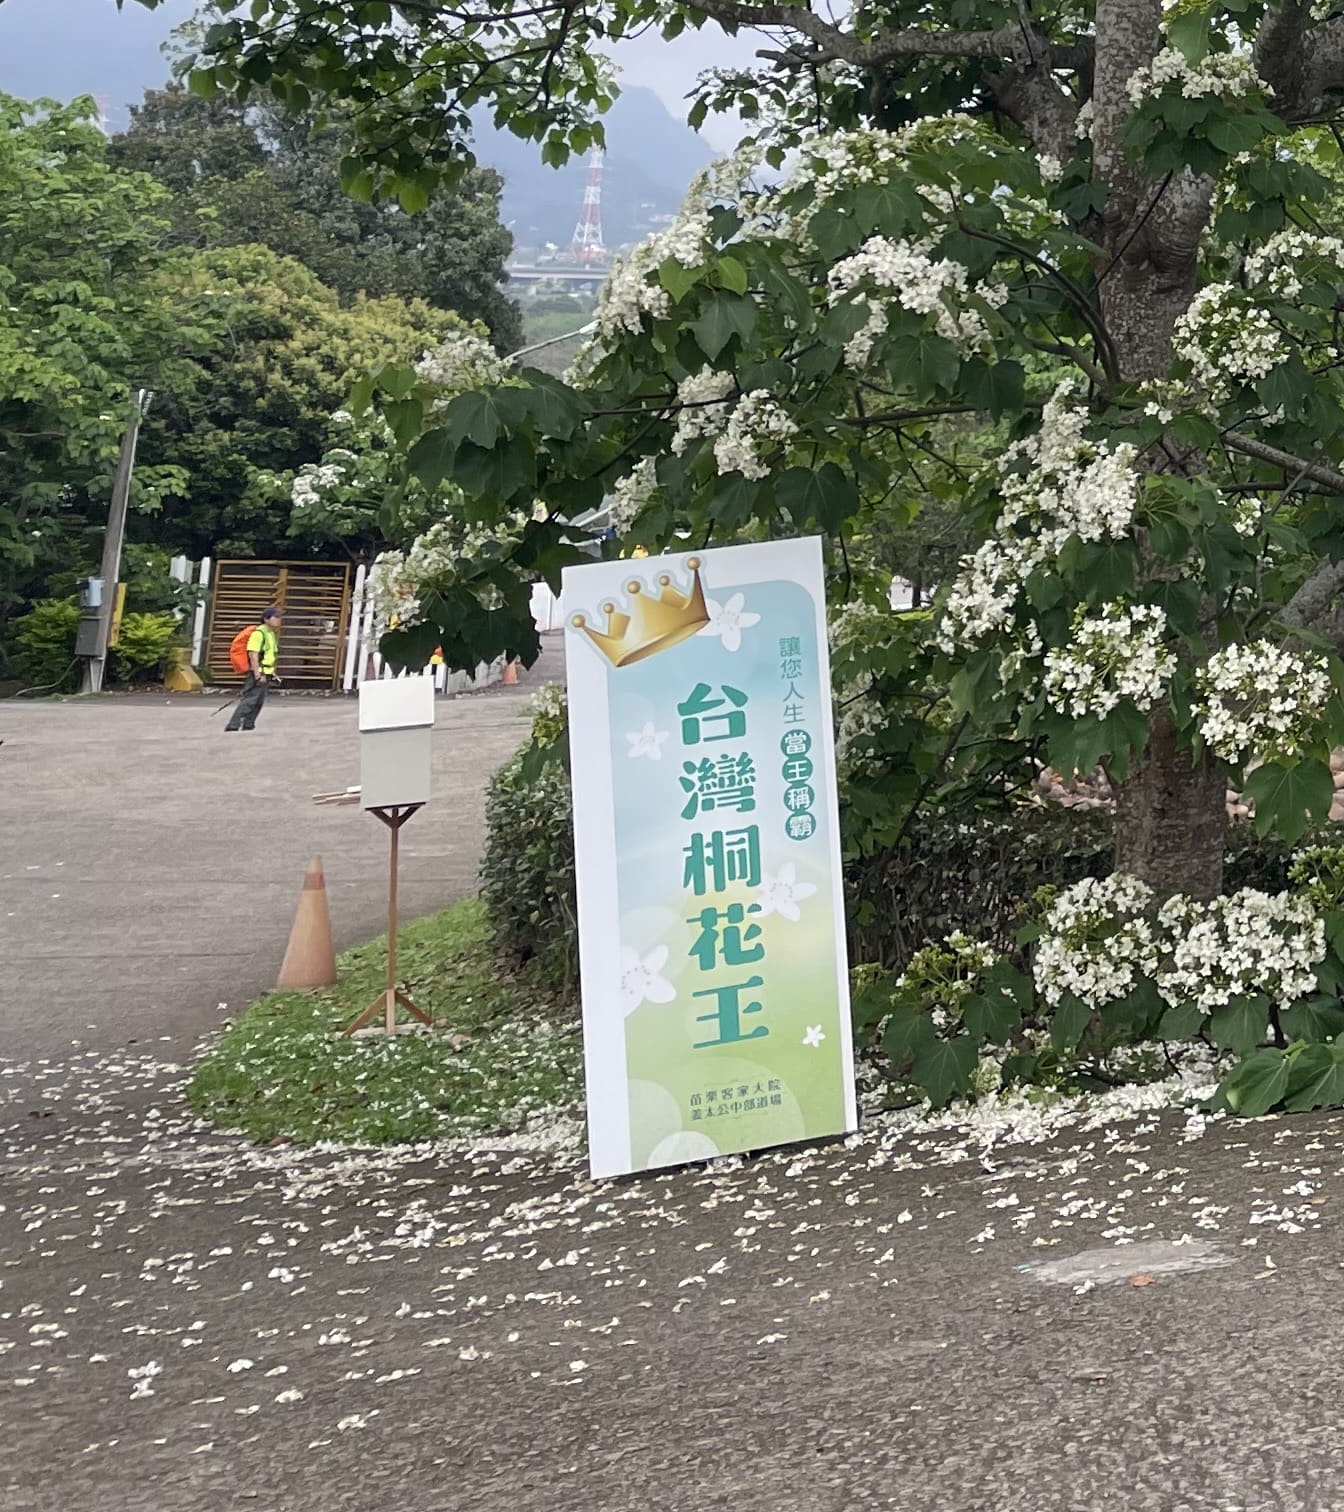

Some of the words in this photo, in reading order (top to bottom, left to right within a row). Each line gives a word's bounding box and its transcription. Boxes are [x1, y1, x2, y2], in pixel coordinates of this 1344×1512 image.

[677, 682, 769, 1049] 台灣桐花王
[779, 637, 813, 838] 讓您人生當王稱霸
